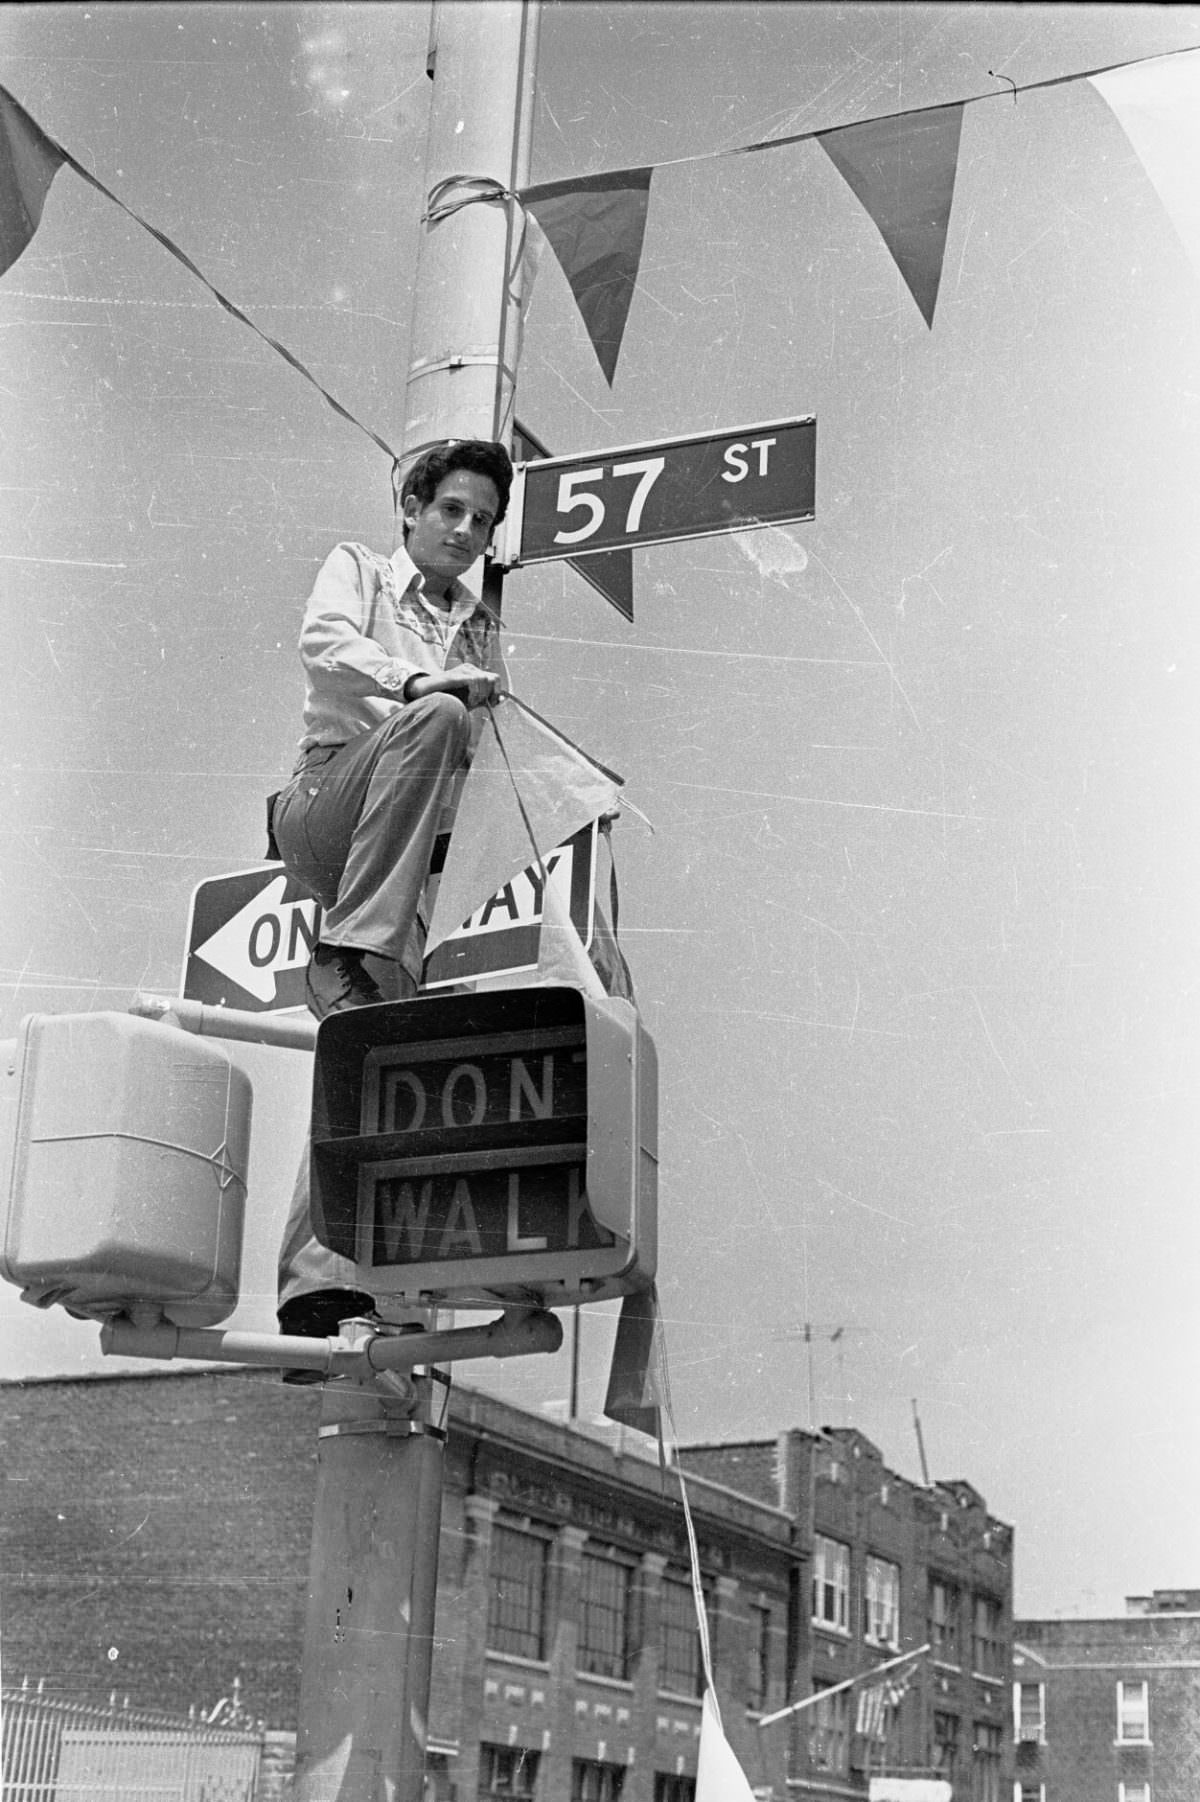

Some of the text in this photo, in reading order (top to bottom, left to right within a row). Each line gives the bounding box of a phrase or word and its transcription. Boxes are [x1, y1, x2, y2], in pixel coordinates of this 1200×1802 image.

[553, 438, 777, 544] 57 ST
[248, 855, 561, 967] ON AY
[384, 1054, 586, 1133] DON
[374, 1169, 614, 1261] WALK
